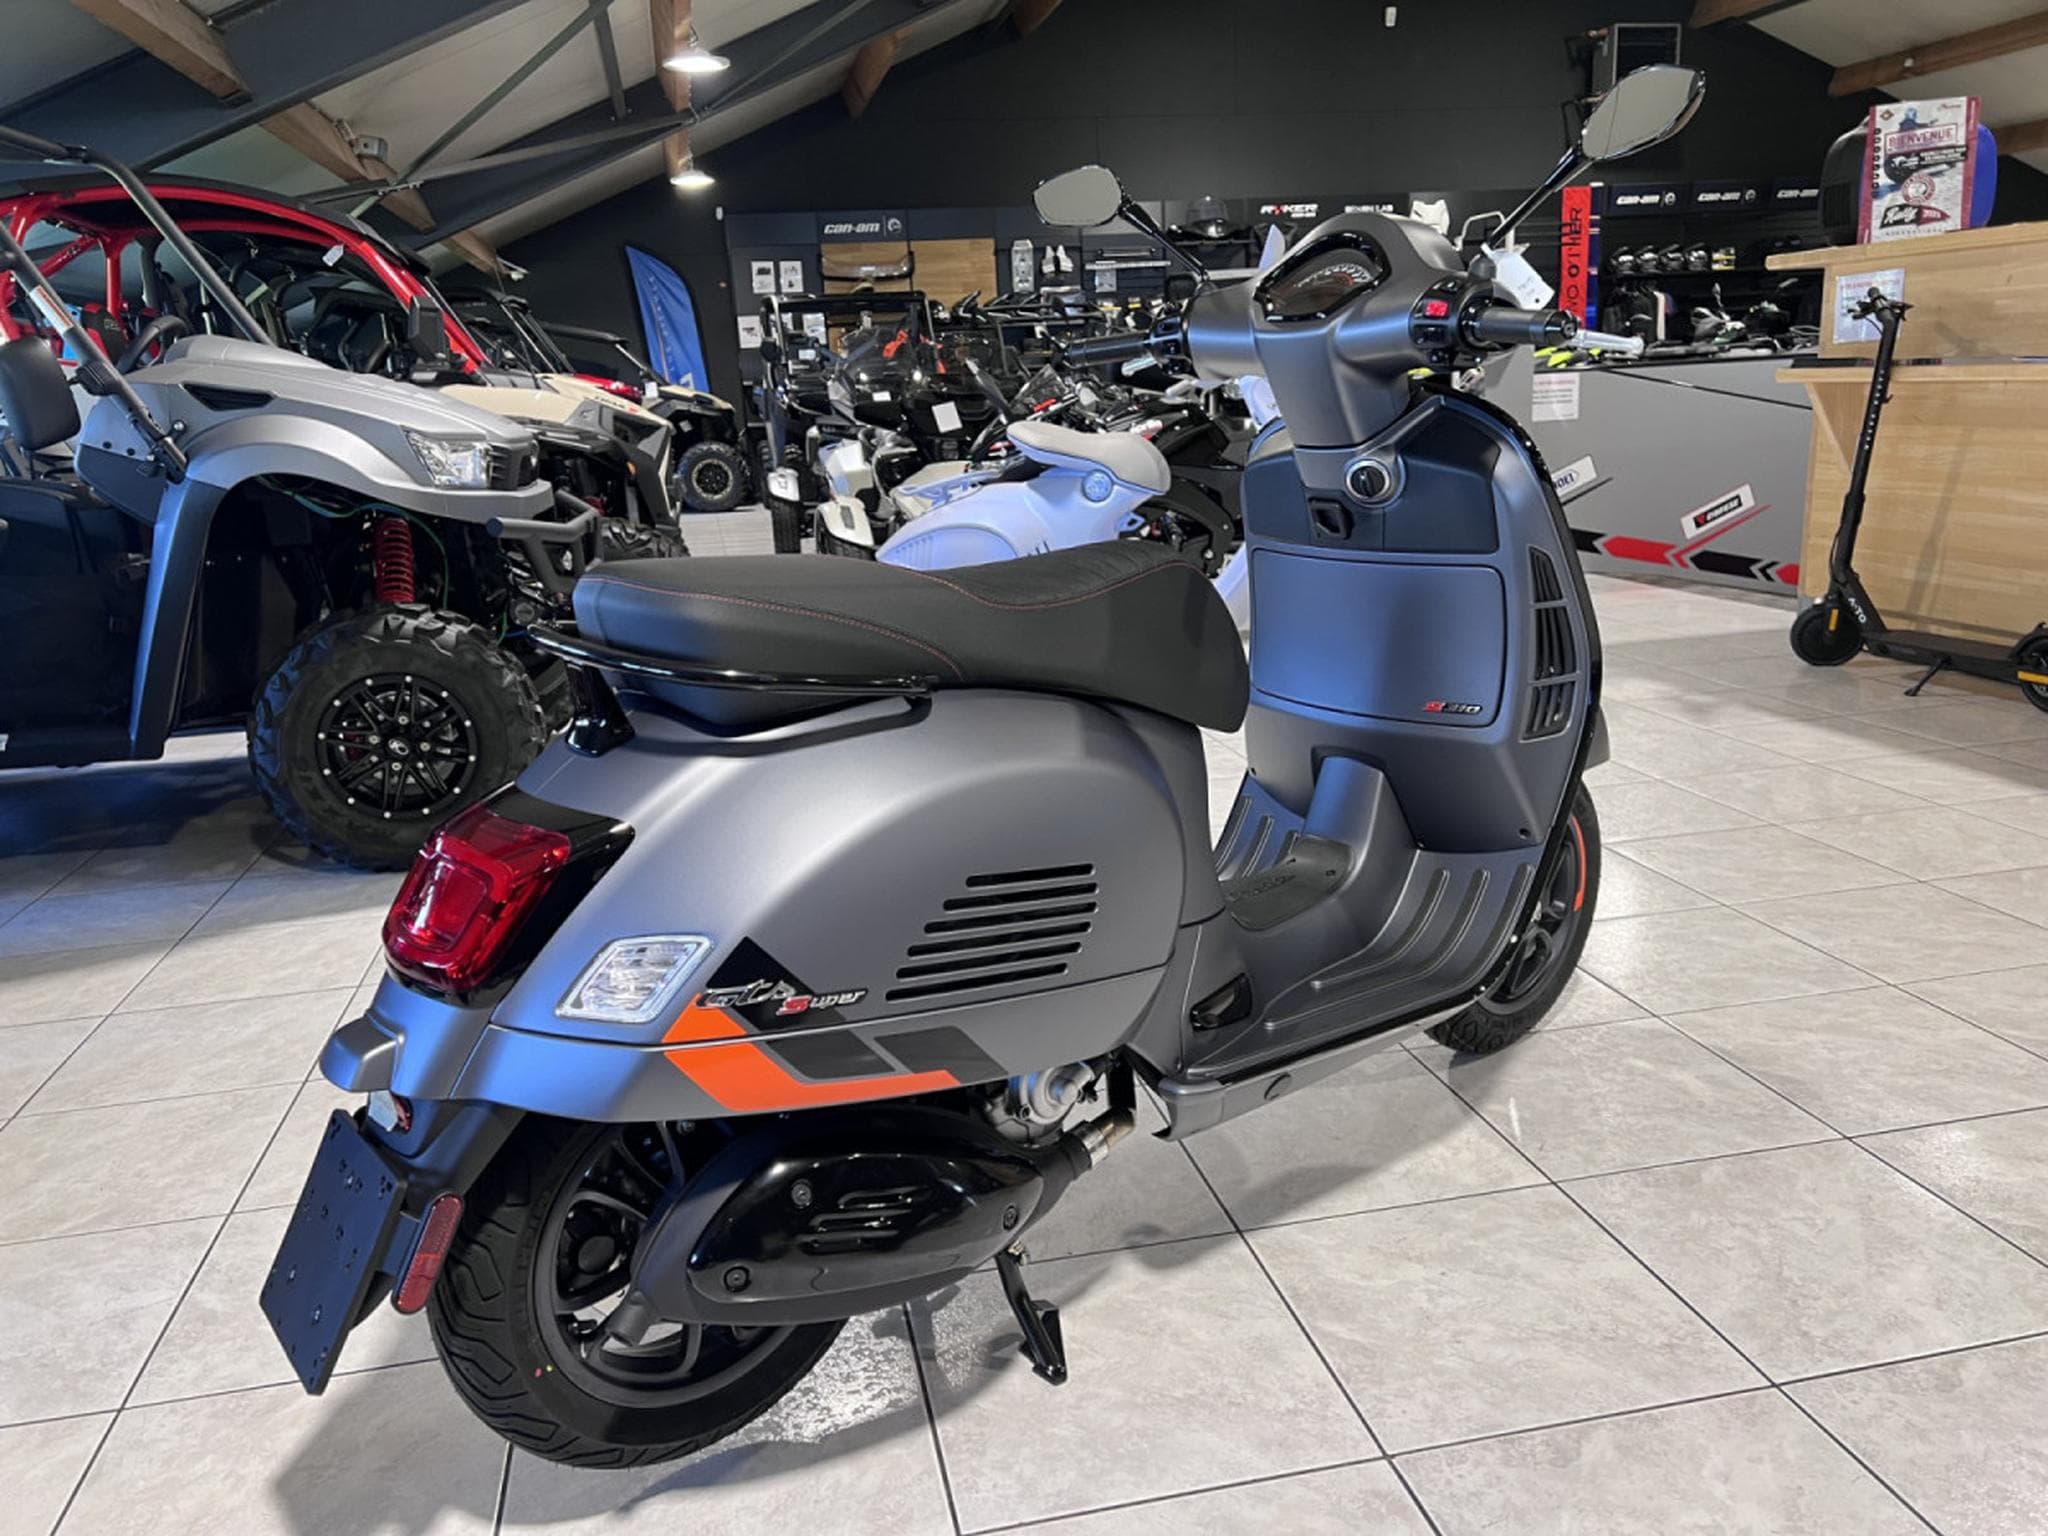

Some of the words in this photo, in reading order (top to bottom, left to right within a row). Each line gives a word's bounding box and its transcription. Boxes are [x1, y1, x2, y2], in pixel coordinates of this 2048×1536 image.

[1888, 127, 1953, 147] BIENVENUE
[823, 222, 881, 234] can-am
[775, 990, 867, 1016] Super
